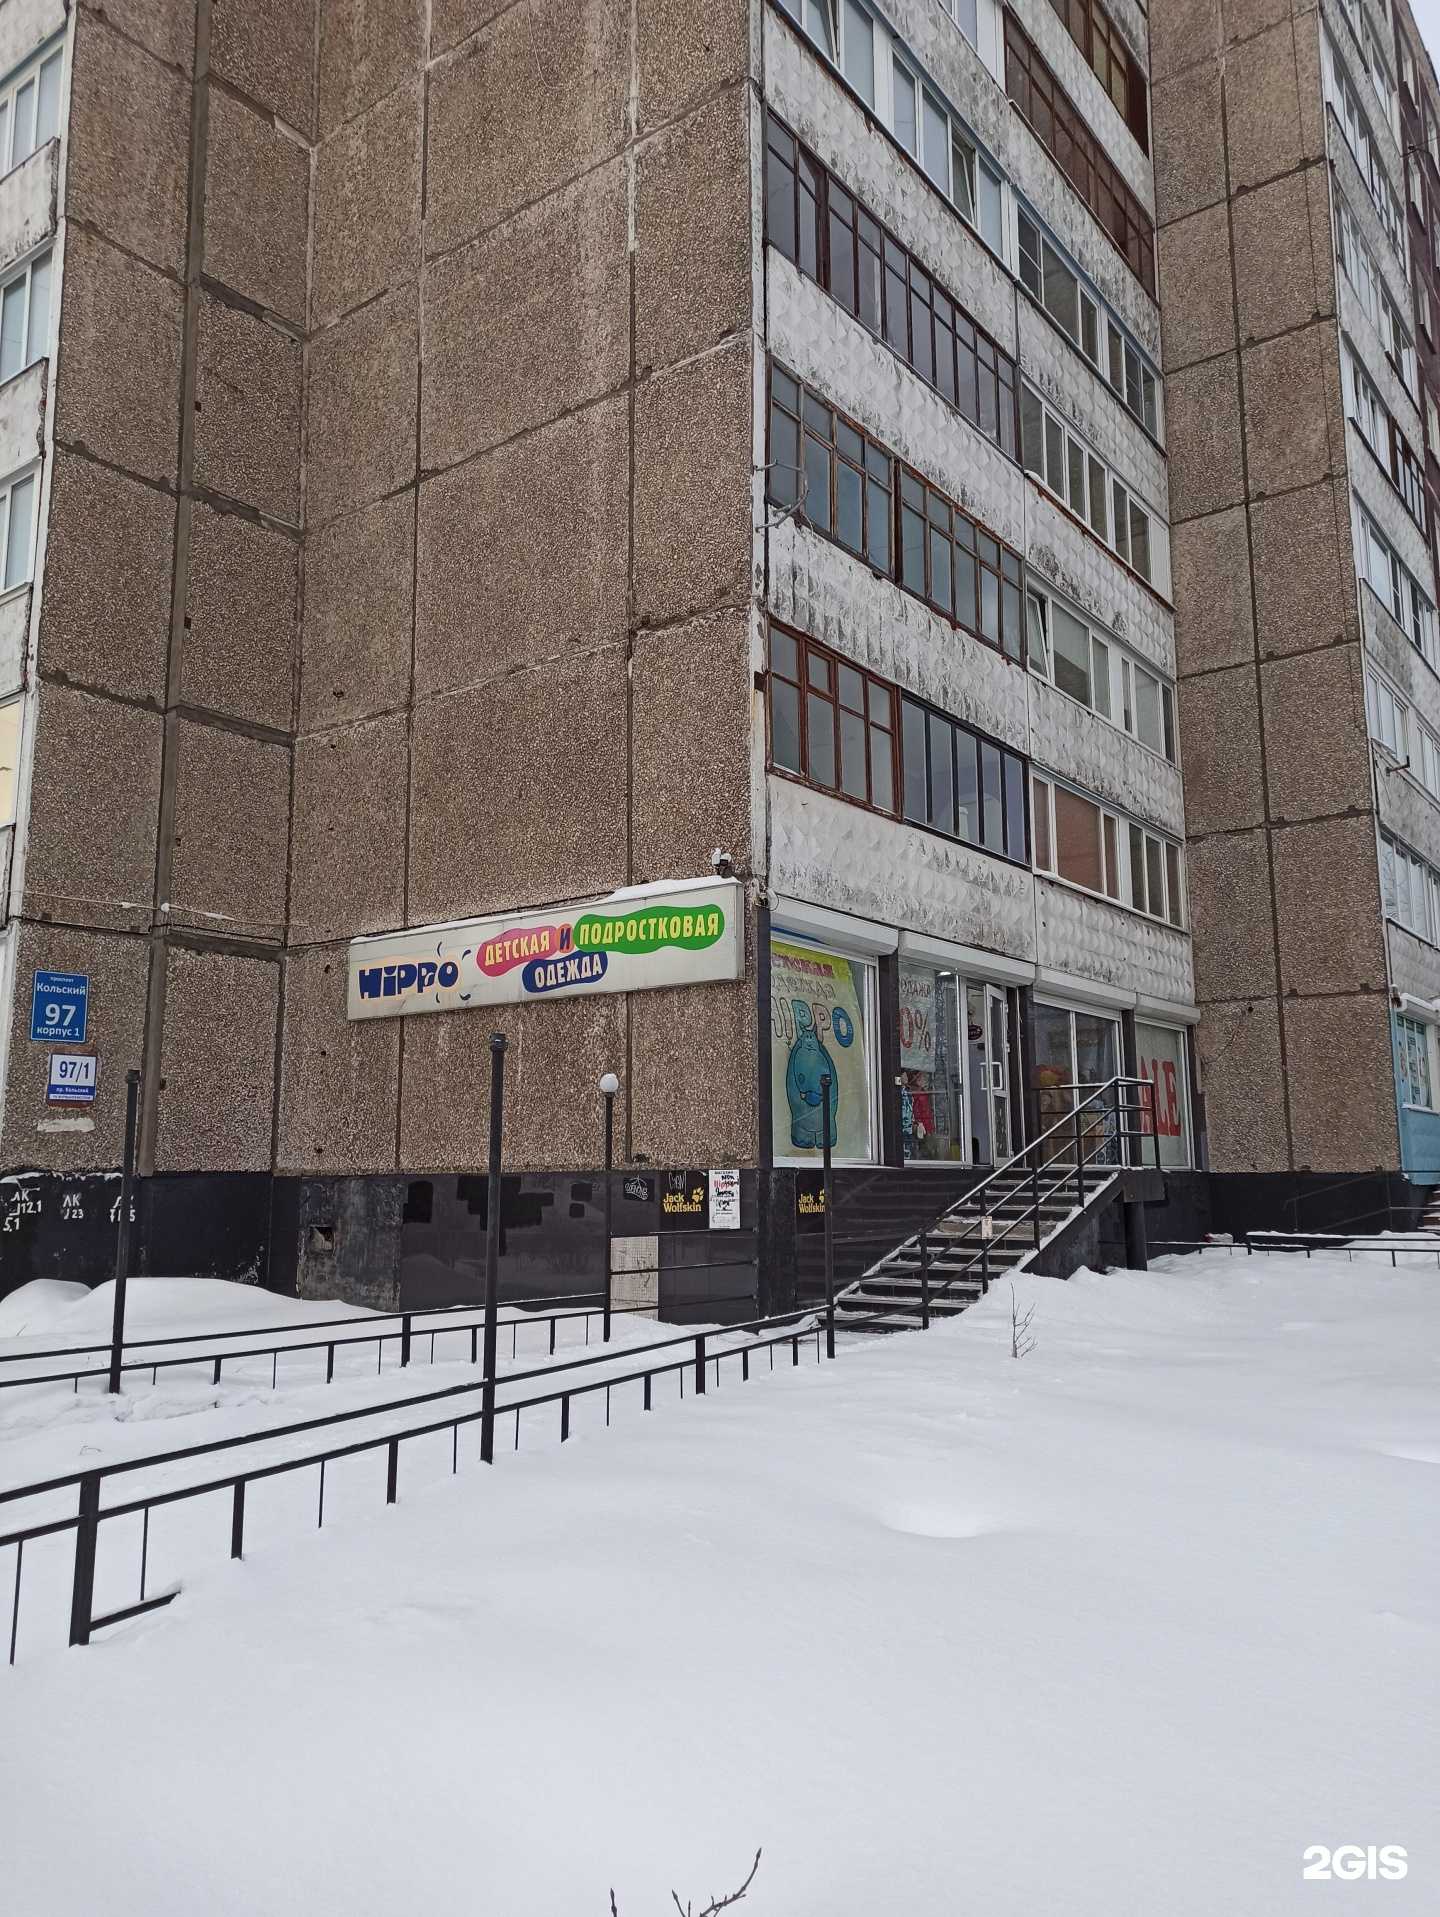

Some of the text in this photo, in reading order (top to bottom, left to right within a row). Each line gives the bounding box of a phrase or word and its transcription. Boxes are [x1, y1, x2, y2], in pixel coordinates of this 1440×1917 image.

[484, 912, 719, 967] ДЕТСКАЯ И ПОДРОСТКОВАЯ
[533, 953, 603, 989] ОДЕЖДА
[36, 983, 86, 996] Кольский
[45, 1003, 76, 1026] 97
[36, 1026, 80, 1037] корпус 1
[59, 1060, 89, 1083] 97/1
[663, 1193, 685, 1203] Jack
[799, 1193, 814, 1204] Jack
[663, 1202, 702, 1213] Wolfskin
